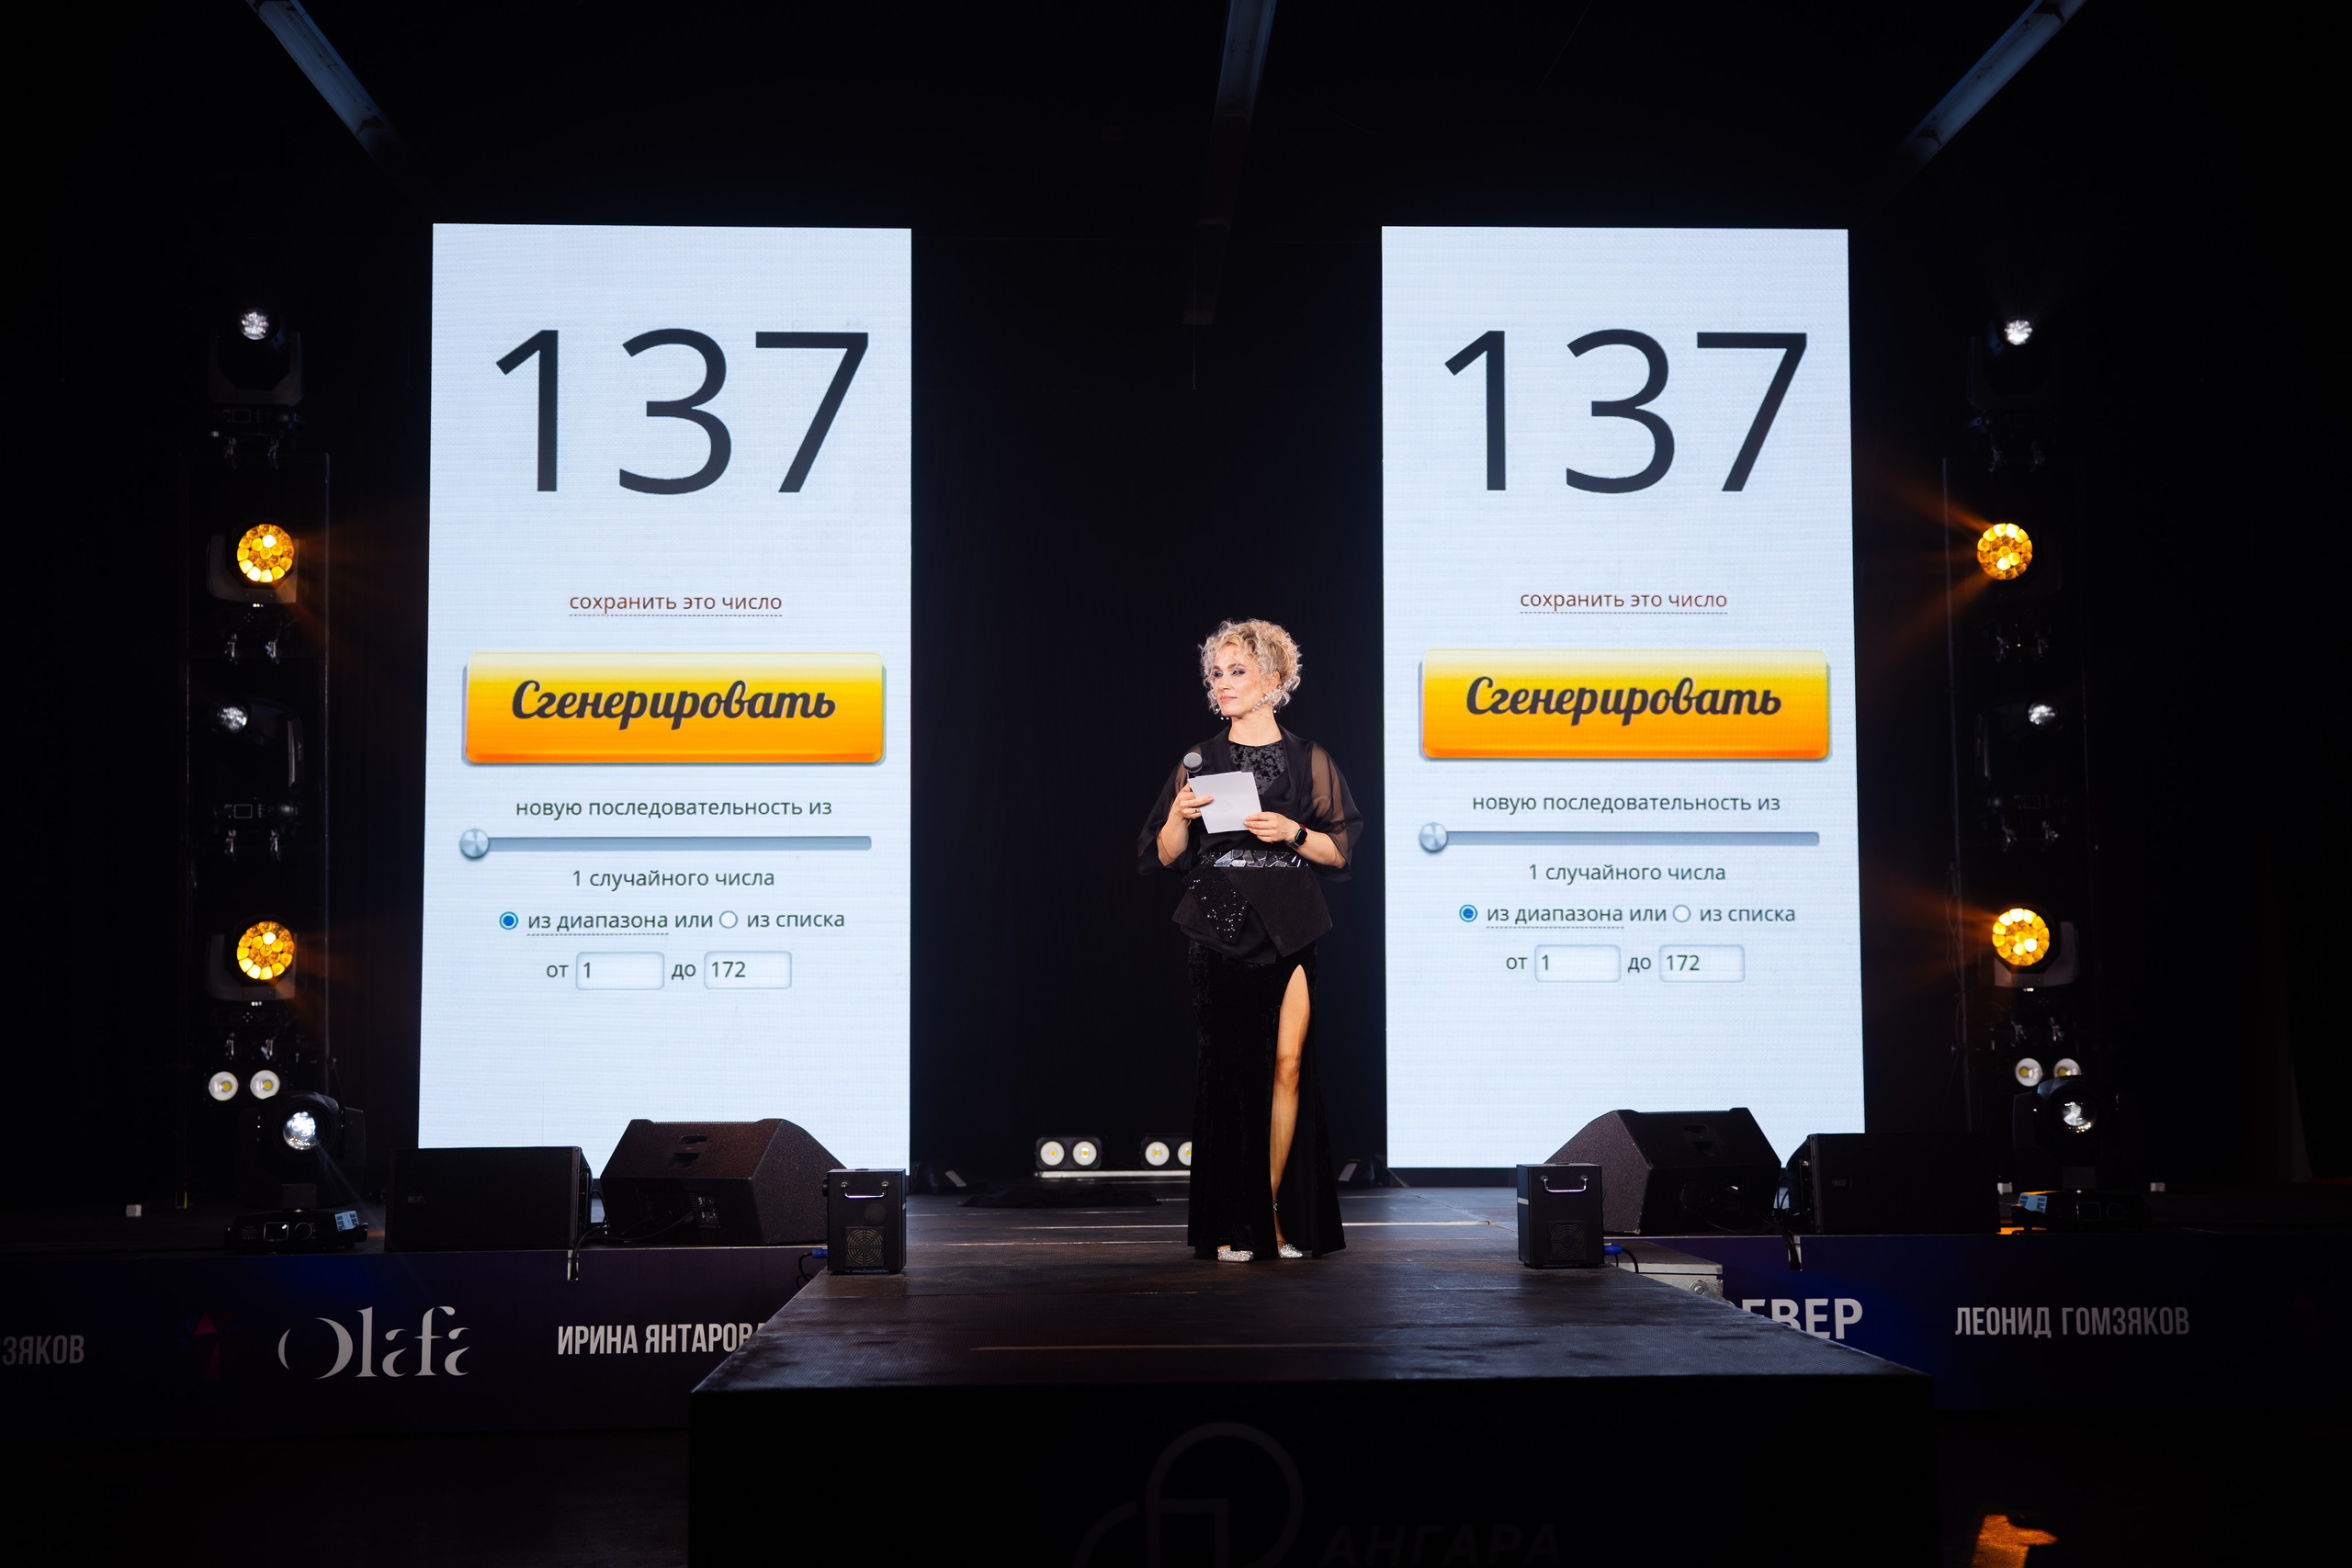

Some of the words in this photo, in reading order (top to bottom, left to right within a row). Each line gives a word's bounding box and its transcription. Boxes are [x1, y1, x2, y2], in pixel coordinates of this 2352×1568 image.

[495, 328, 869, 495] 137
[1444, 329, 1807, 494] 137
[570, 596, 677, 615] сохранить
[683, 597, 716, 610] это
[722, 597, 782, 610] число
[1521, 594, 1624, 612] сохранить
[1631, 594, 1662, 607] это
[1668, 595, 1727, 607] число
[512, 680, 836, 730] Сгенерировать
[1466, 676, 1781, 727] Сгенерировать
[516, 803, 582, 821] новую
[589, 802, 803, 818] последовательность
[809, 802, 832, 815] из
[1473, 797, 1537, 816] новую
[1544, 797, 1751, 814] последовательность
[1758, 798, 1781, 811] из
[572, 870, 580, 886] 1
[590, 870, 709, 892] случайного
[715, 873, 775, 886] числа
[1530, 863, 1536, 880] 1
[1545, 864, 1662, 886] случайного
[1668, 867, 1725, 880] числа
[528, 916, 551, 929] из
[556, 915, 668, 931] диапазона
[675, 915, 713, 928] или
[747, 915, 770, 928] из
[775, 914, 844, 928] списка
[1487, 908, 1510, 921] из
[1514, 908, 1623, 925] диапазона
[1630, 908, 1667, 921] или
[1701, 909, 1722, 922] из
[1728, 909, 1795, 922] списка
[546, 964, 569, 978] от
[583, 962, 590, 978] 1
[671, 964, 696, 980] до
[712, 961, 746, 978] 172
[1506, 956, 1526, 970] от
[1542, 954, 1548, 971] 1
[1627, 957, 1651, 973] до
[1667, 954, 1700, 971] 172
[1954, 1306, 2052, 1338] ЛЕОНИД
[2061, 1306, 2189, 1336] ГОМЗЯКОВ
[1, 1334, 85, 1366] ЗЯКОВ
[277, 1305, 472, 1379] Olafa
[558, 1325, 639, 1355] ИРИНА
[644, 1323, 765, 1353] ЯНТАРОВ
[1318, 1523, 1561, 1568] АНГАРА
